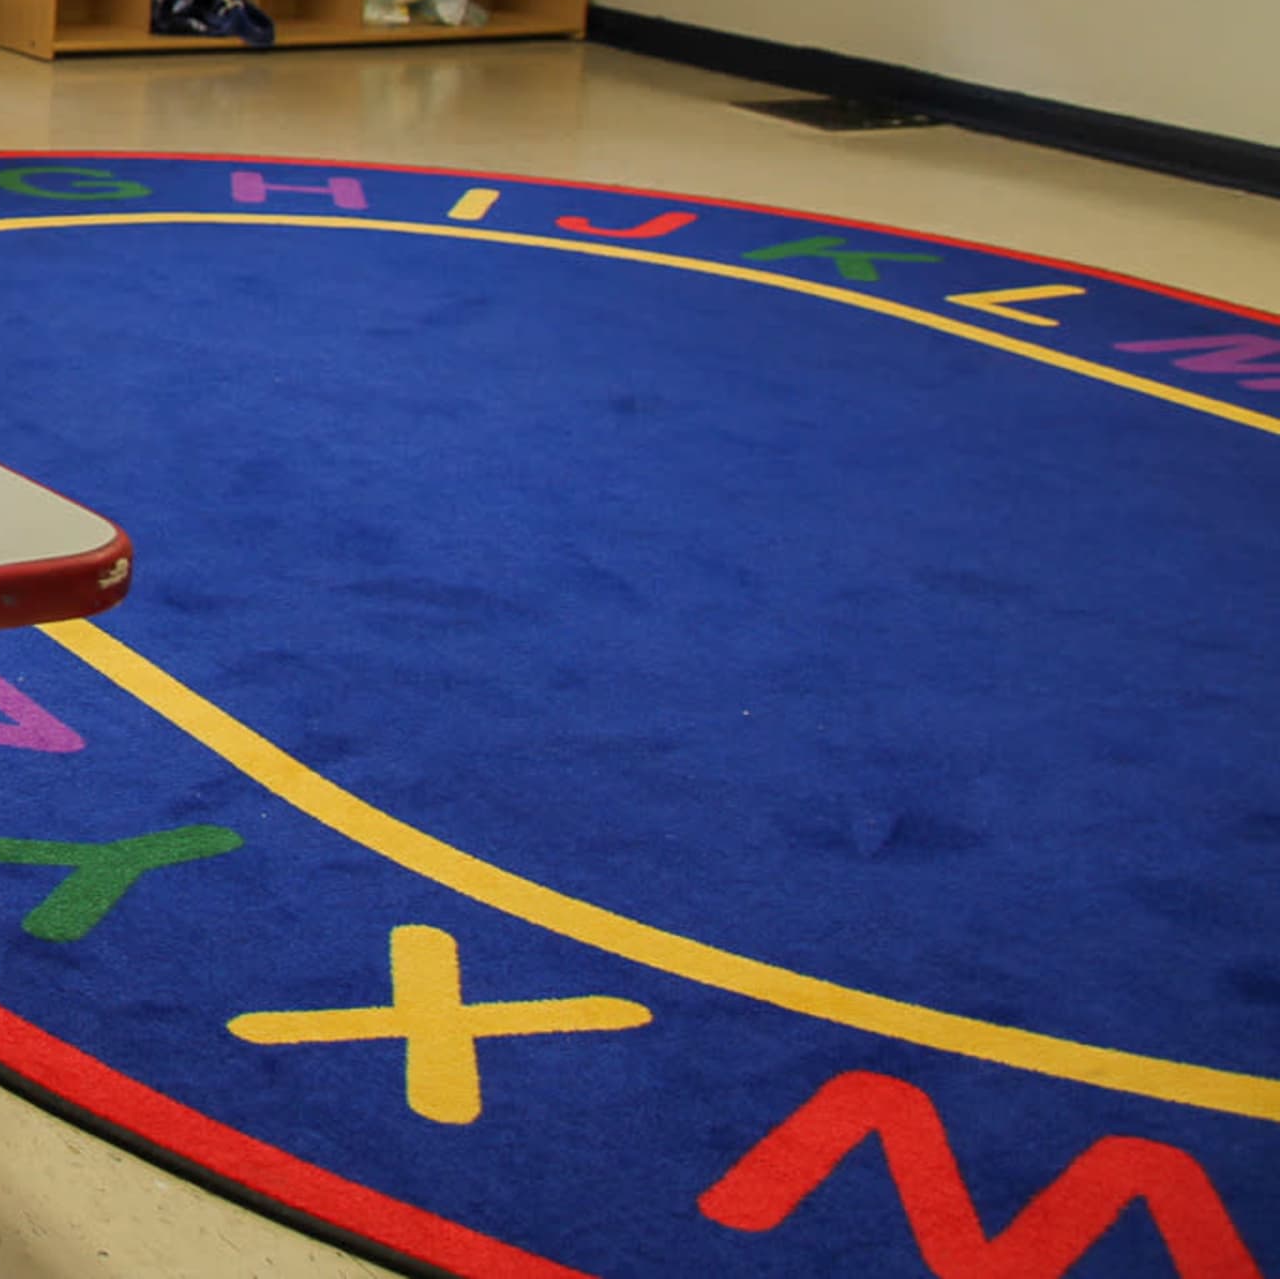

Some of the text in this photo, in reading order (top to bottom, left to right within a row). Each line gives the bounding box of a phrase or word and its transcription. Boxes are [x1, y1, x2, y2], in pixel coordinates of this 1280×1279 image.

[230, 170, 367, 210] H
[448, 188, 500, 220] I
[556, 211, 697, 239] J
[741, 235, 943, 282] K
[944, 283, 1086, 327] L
[1113, 333, 1280, 392] M
[227, 923, 653, 1125] X
